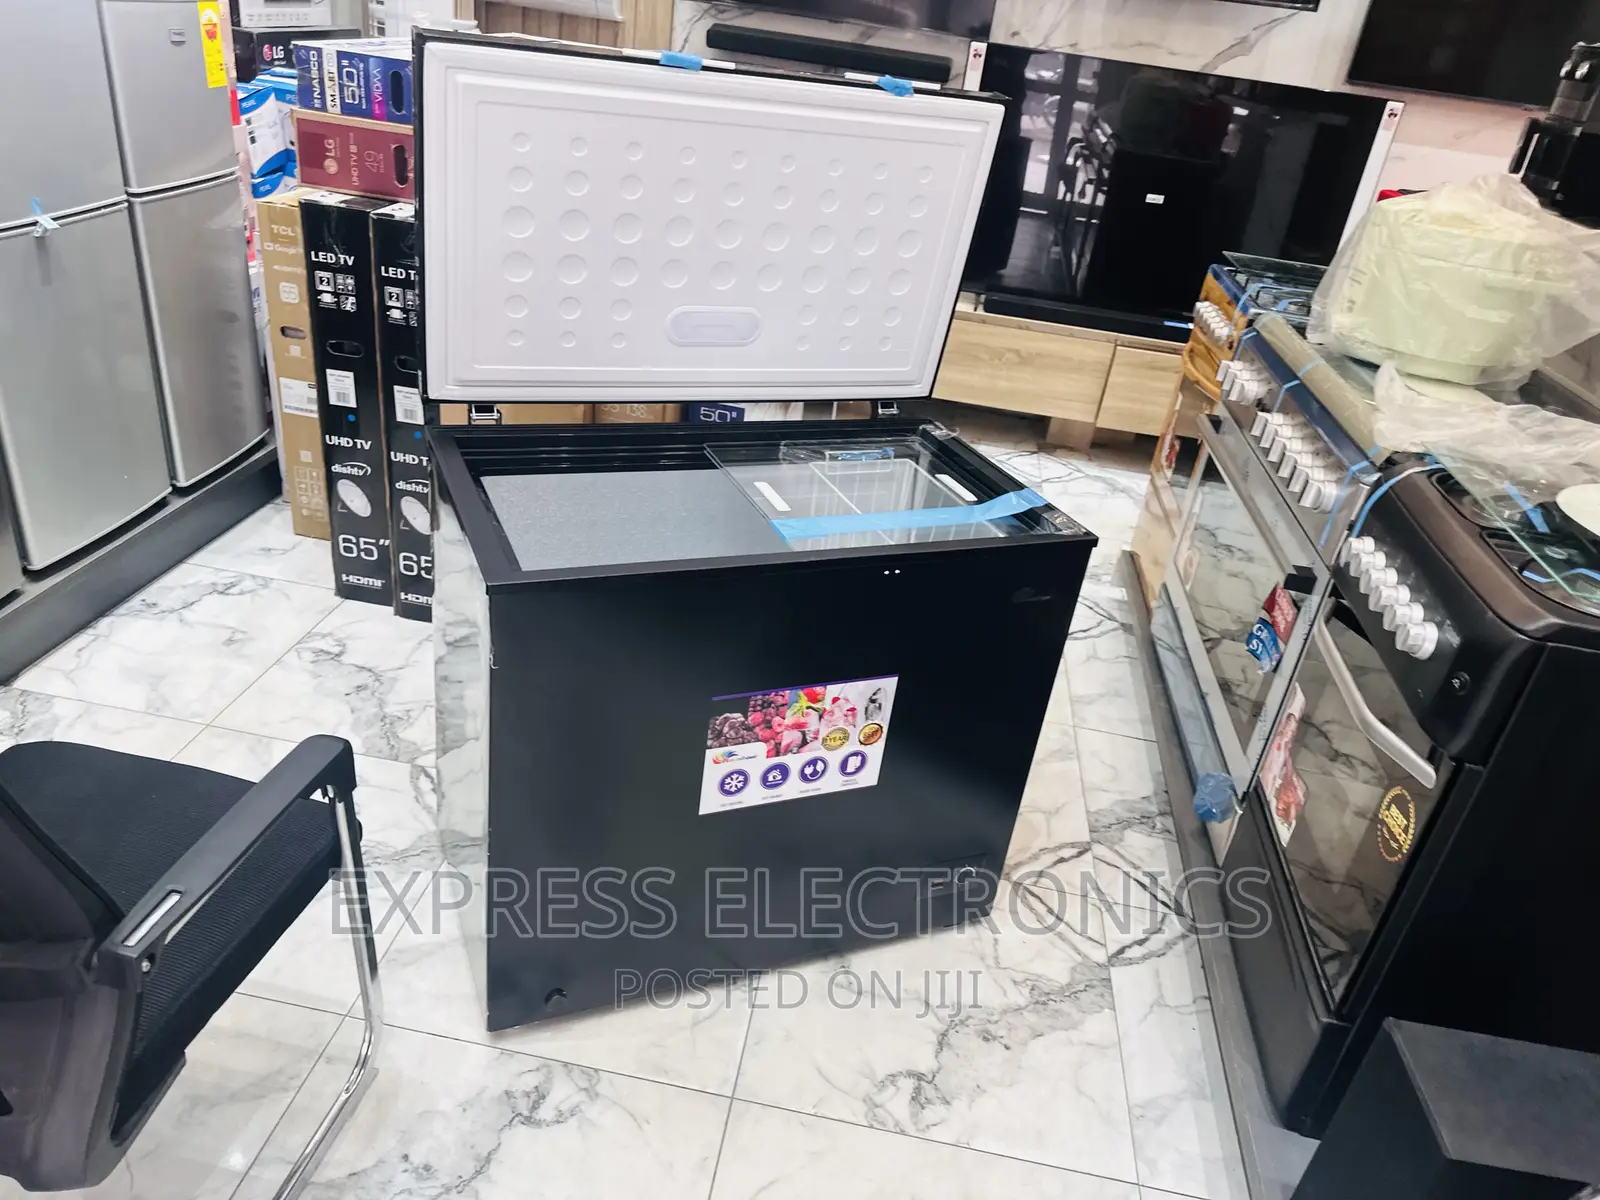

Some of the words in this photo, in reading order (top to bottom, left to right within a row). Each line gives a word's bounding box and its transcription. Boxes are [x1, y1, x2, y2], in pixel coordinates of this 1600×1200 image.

[272, 45, 285, 59] LG
[327, 71, 337, 109] SMART
[324, 139, 336, 157] LG
[350, 153, 358, 166] TV
[363, 150, 380, 173] 49
[350, 166, 360, 186] UHD
[271, 224, 297, 236] TCL
[310, 250, 337, 264] LED
[338, 254, 355, 266] TV
[380, 265, 407, 279] LED
[408, 270, 417, 281] T
[325, 434, 353, 448] UHD
[354, 438, 372, 450] TV
[390, 451, 419, 465] UHD
[420, 456, 430, 467] T
[400, 591, 433, 605] HDM
